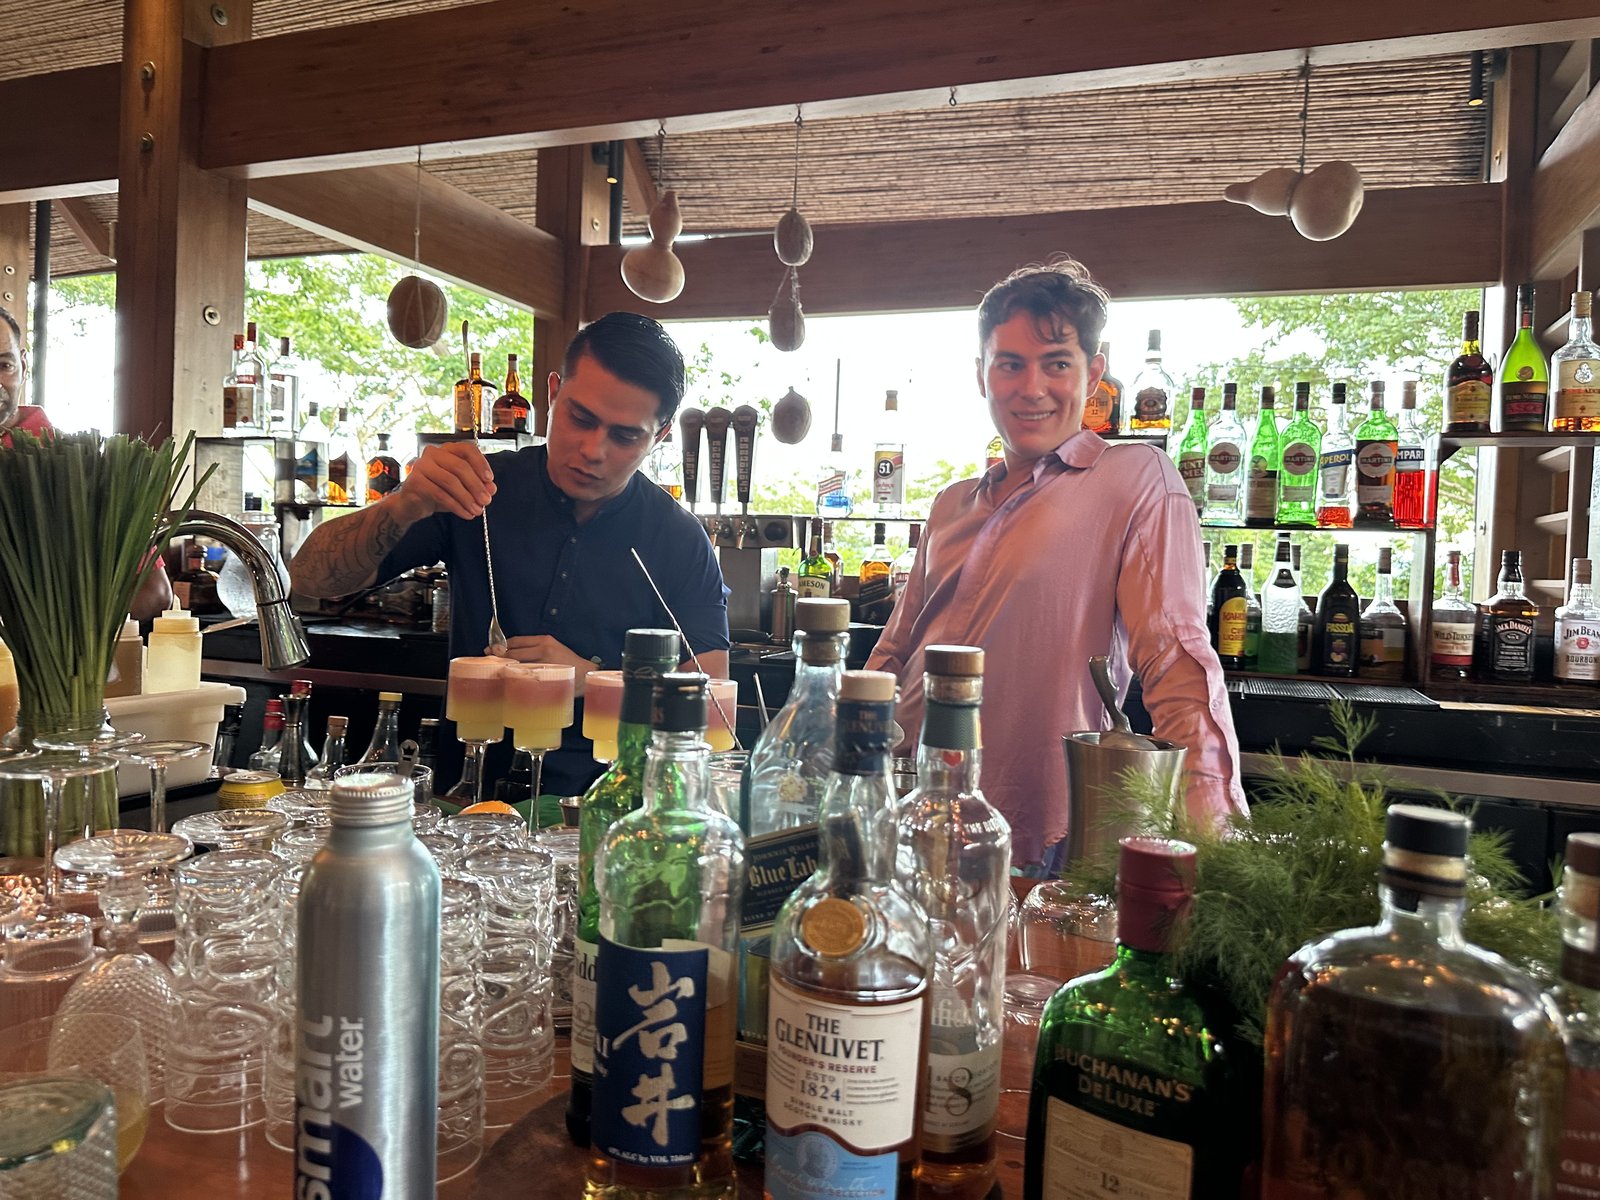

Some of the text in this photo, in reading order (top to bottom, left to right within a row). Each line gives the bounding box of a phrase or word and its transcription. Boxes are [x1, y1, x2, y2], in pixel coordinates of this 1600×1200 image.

[879, 463, 890, 474] 51
[1320, 453, 1350, 465] APEROL
[1433, 631, 1451, 640] WILD
[1564, 628, 1580, 639] JIM
[1566, 655, 1598, 664] BOURBON
[748, 864, 786, 889] Blue
[805, 1012, 841, 1035] THE
[775, 1017, 885, 1062] GLENLIVET
[611, 959, 697, 1148] 岩井
[777, 1043, 878, 1075] FOUNDER'S RESERVE
[1054, 1043, 1192, 1103] BUCHANAN'S
[799, 1079, 842, 1102] 1824
[1077, 1073, 1156, 1118] DELUXE
[783, 1101, 864, 1127] SCOTCH WHISKY
[789, 1095, 855, 1118] SINGLE MALT
[1100, 1170, 1121, 1195] 12
